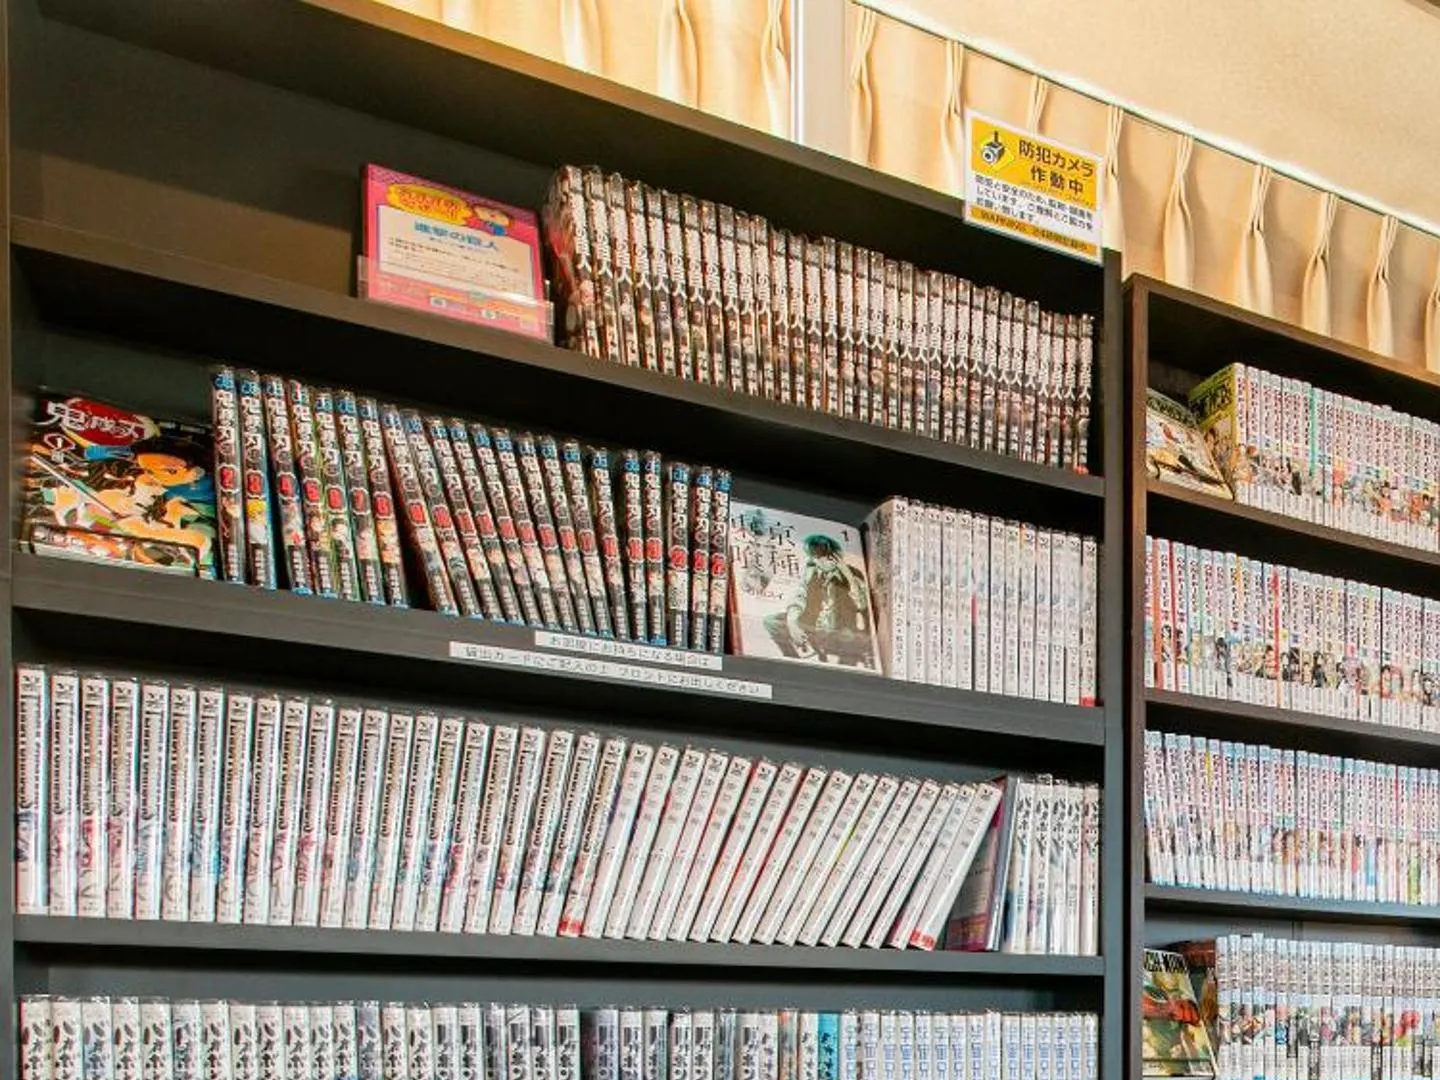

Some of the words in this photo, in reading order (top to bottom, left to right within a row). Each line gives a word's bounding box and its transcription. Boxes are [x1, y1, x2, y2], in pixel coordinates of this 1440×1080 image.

[1018, 139, 1094, 178] 防犯カメラ
[1031, 164, 1084, 196] 作動中
